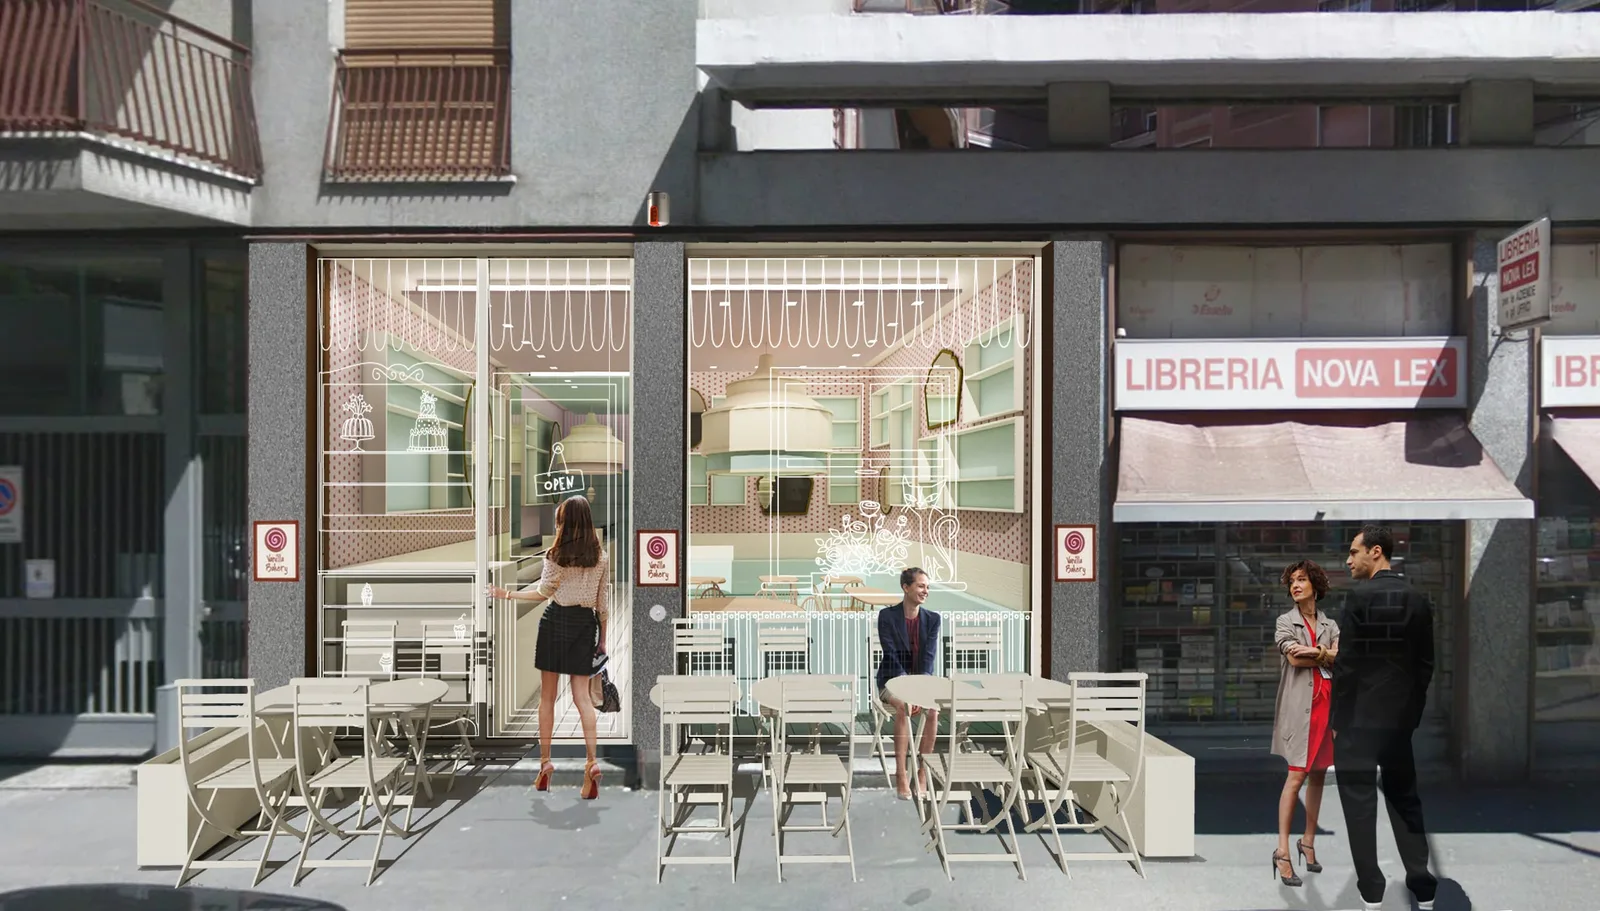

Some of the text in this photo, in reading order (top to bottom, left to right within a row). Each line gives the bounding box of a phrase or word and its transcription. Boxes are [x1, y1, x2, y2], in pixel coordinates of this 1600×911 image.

[1500, 228, 1540, 262] LIBRERIA
[1125, 358, 1448, 391] LIBRERIA NOVA LEX
[544, 475, 574, 491] OPEN
[265, 563, 289, 576] Bakery
[647, 570, 669, 581] Bakery
[1065, 565, 1087, 576] Bakery
